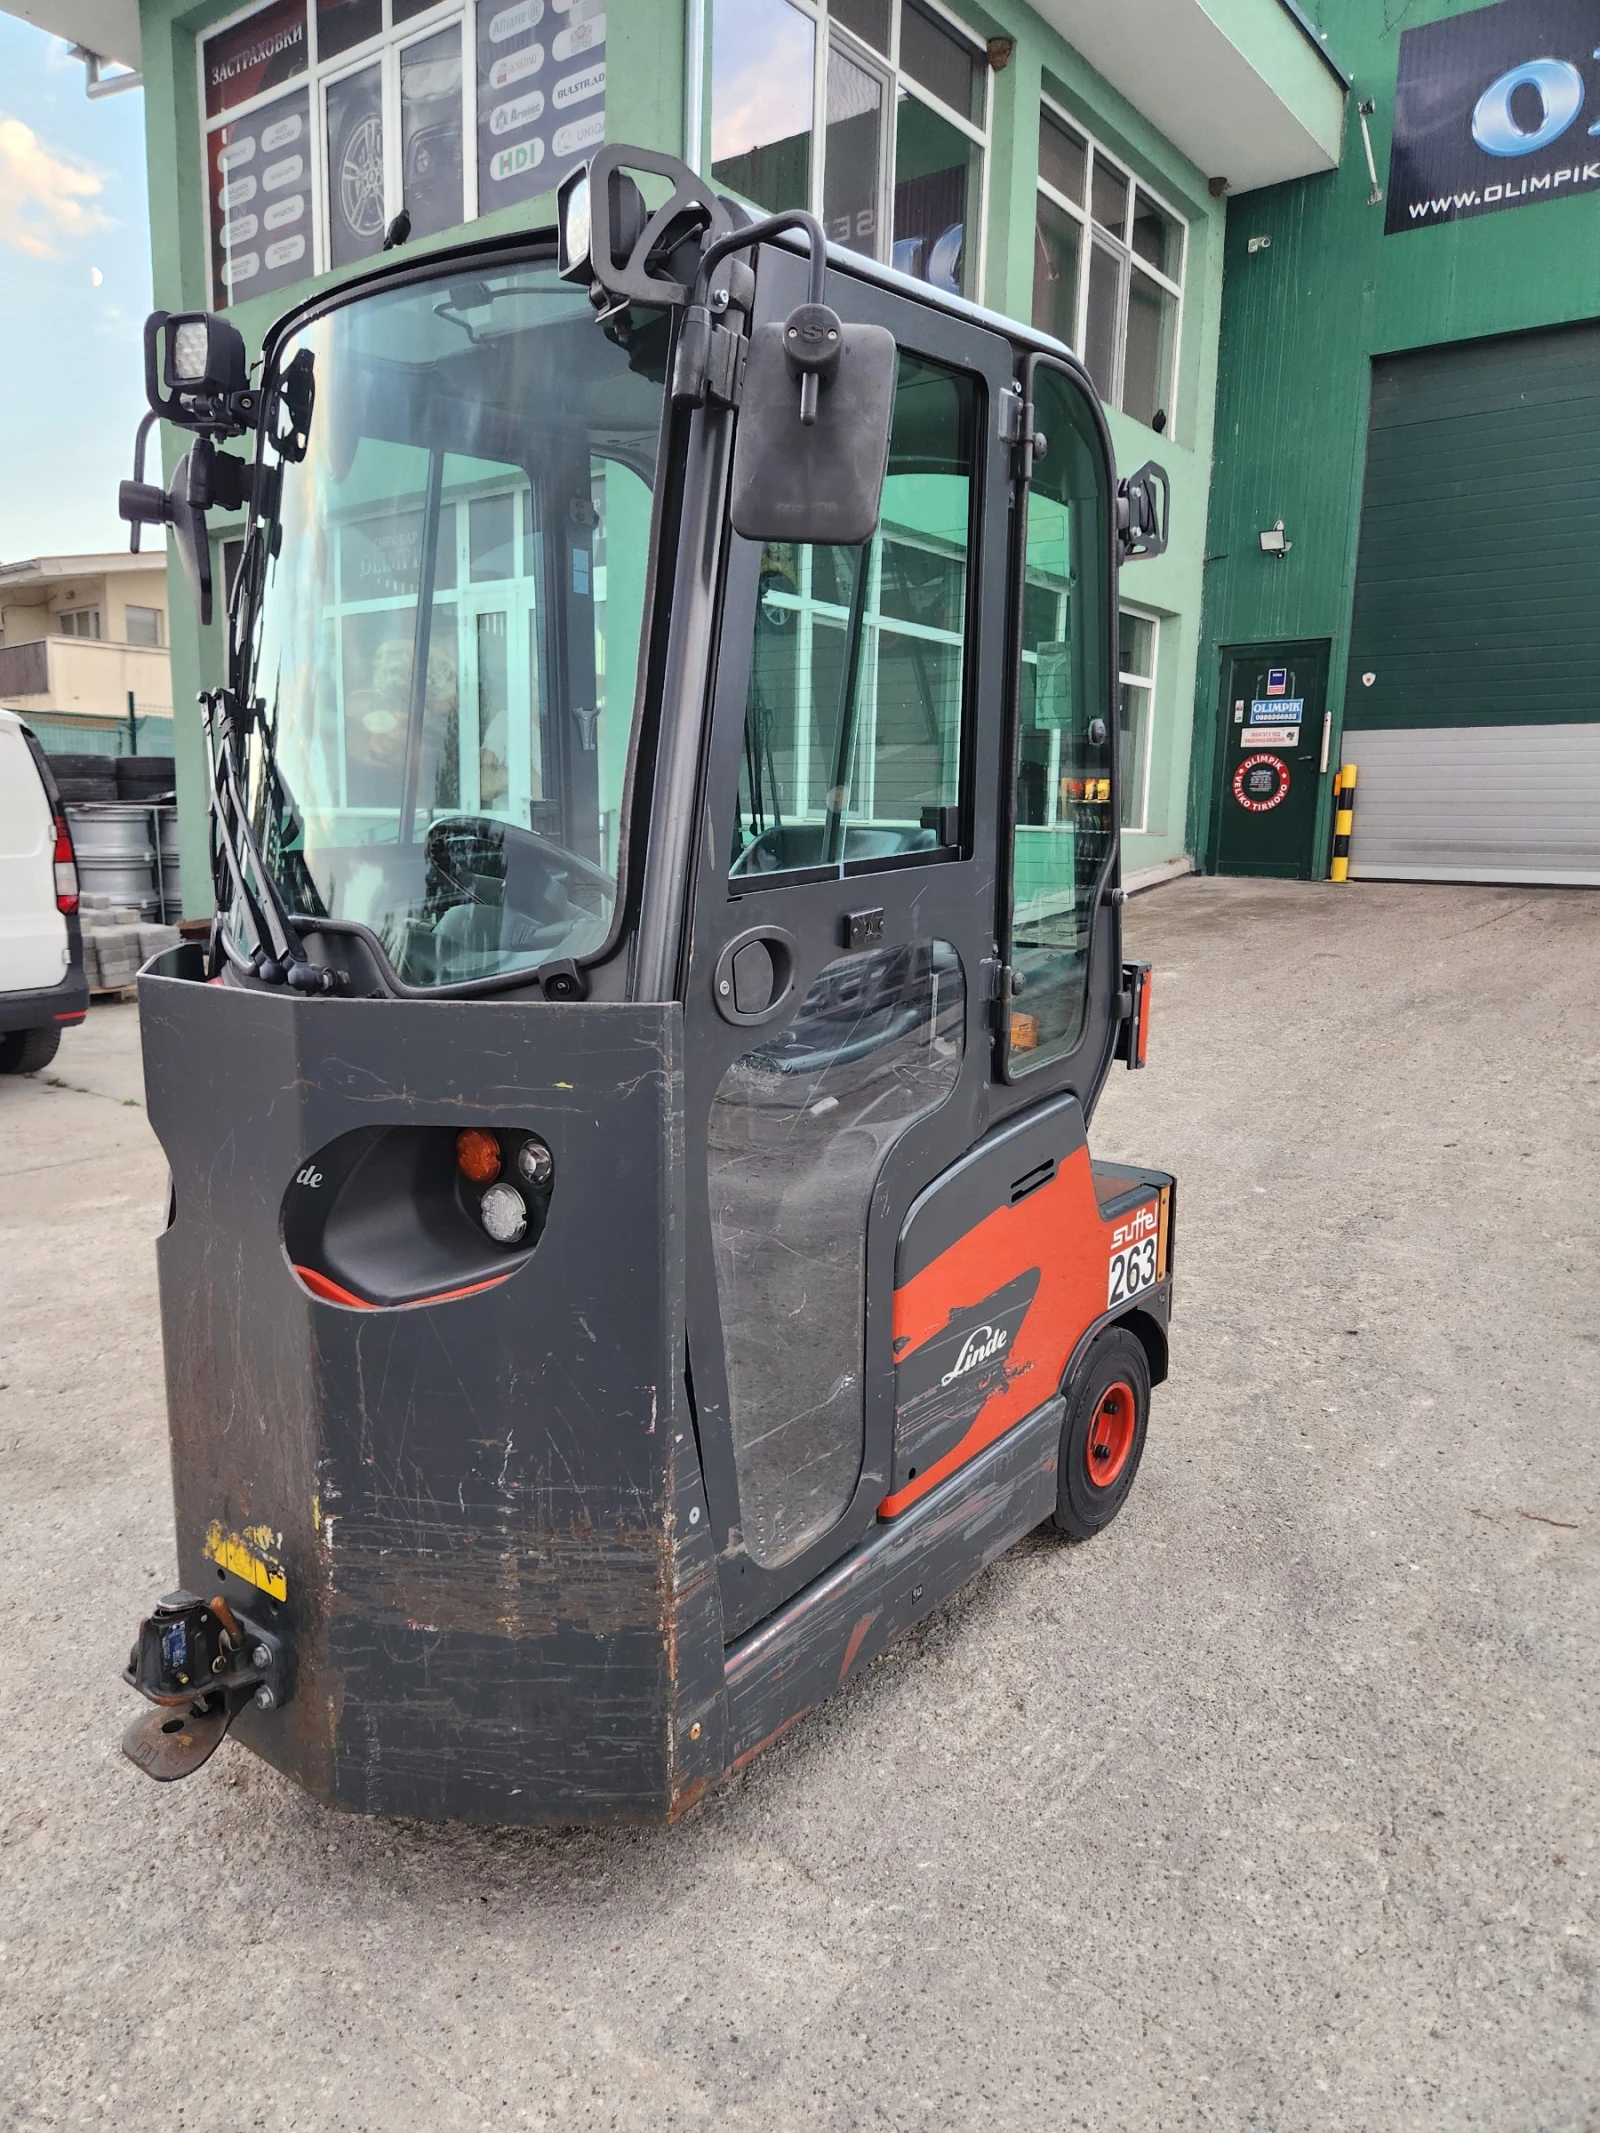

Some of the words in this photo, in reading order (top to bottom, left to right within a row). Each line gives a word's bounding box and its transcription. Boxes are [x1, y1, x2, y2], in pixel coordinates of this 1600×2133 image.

[494, 12, 526, 35] Allianz
[212, 22, 302, 86] ЗАСТРАХОВКИ
[557, 72, 605, 99] BULSTRAD
[499, 142, 535, 176] HDI
[360, 546, 421, 576] OLIMPI
[1253, 702, 1301, 713] OLIMPIK
[1110, 1238, 1155, 1306] 263
[941, 1325, 1007, 1387] Linde
